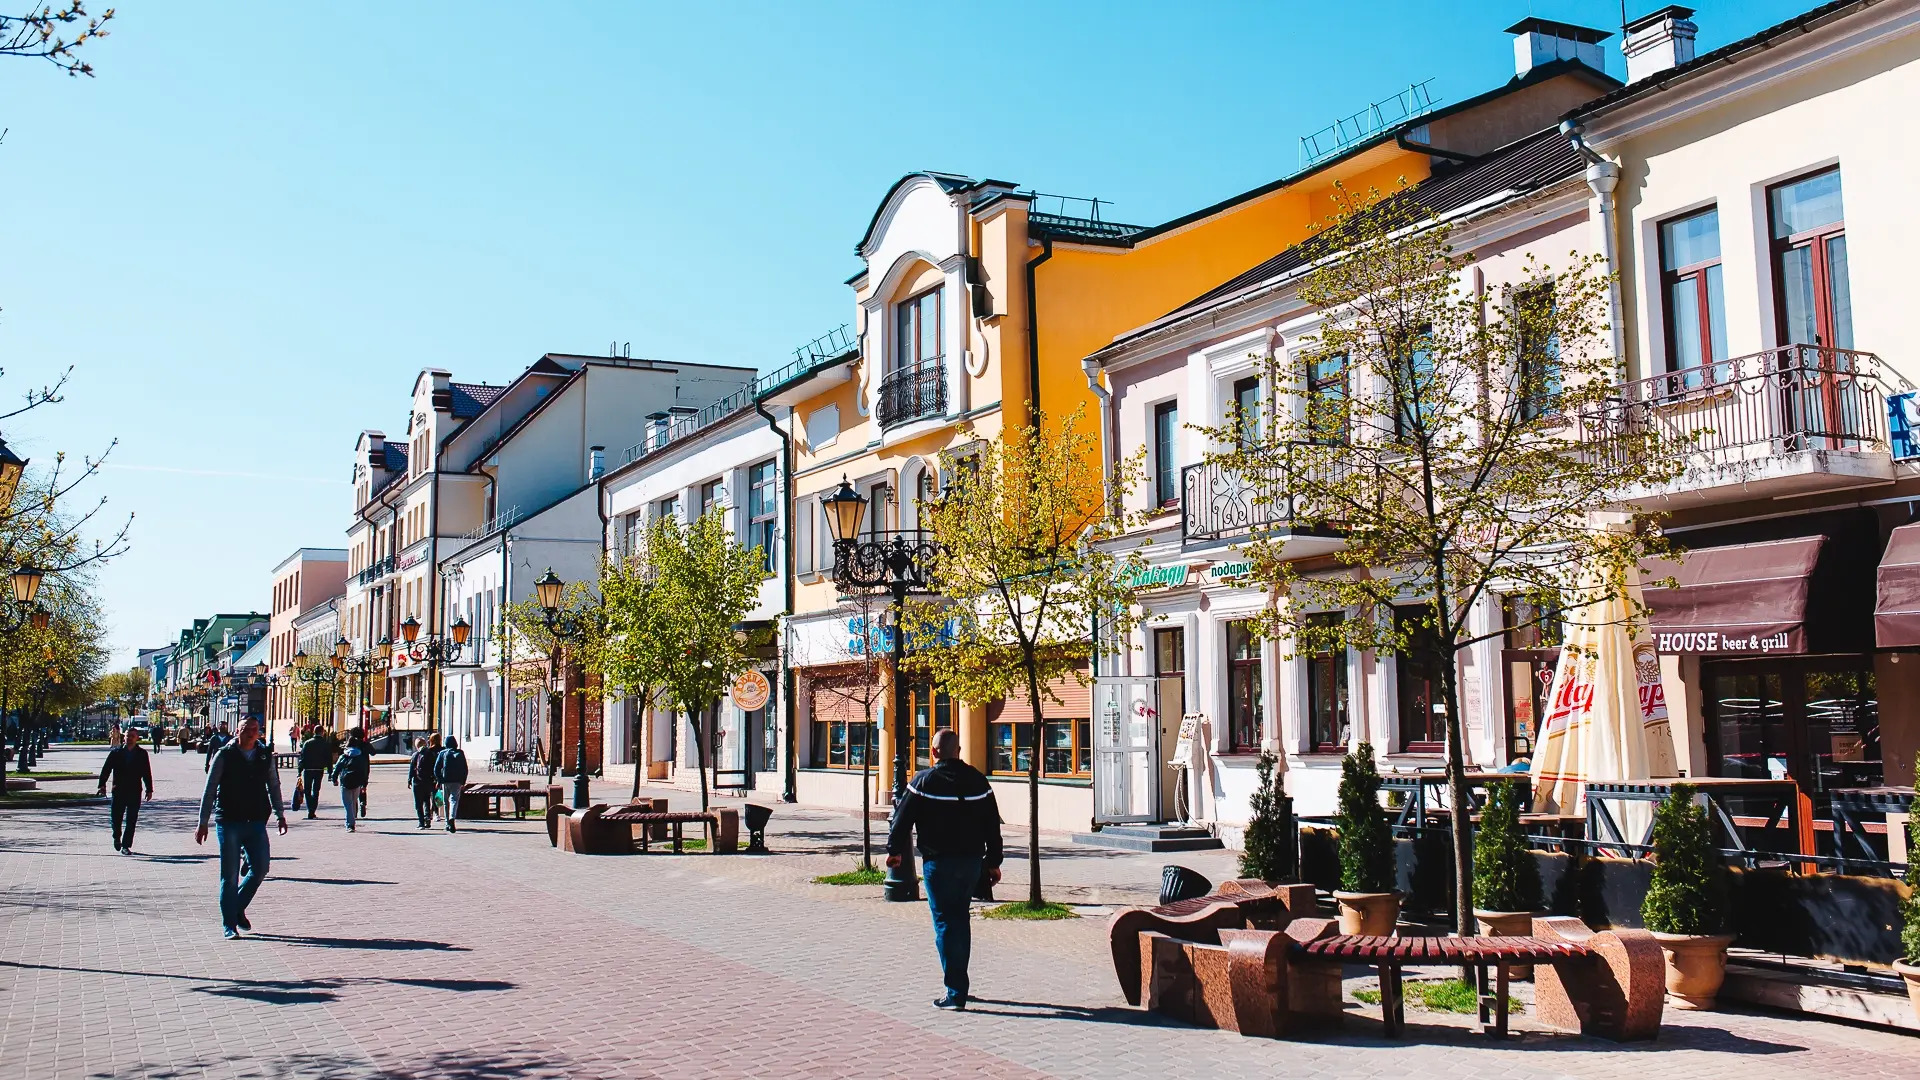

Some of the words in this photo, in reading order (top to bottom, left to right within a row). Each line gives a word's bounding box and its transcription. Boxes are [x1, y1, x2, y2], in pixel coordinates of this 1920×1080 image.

[1658, 632, 1718, 652] HOUSE
[1722, 634, 1748, 651] beer
[1749, 634, 1759, 650] &
[1761, 632, 1789, 653] grill
